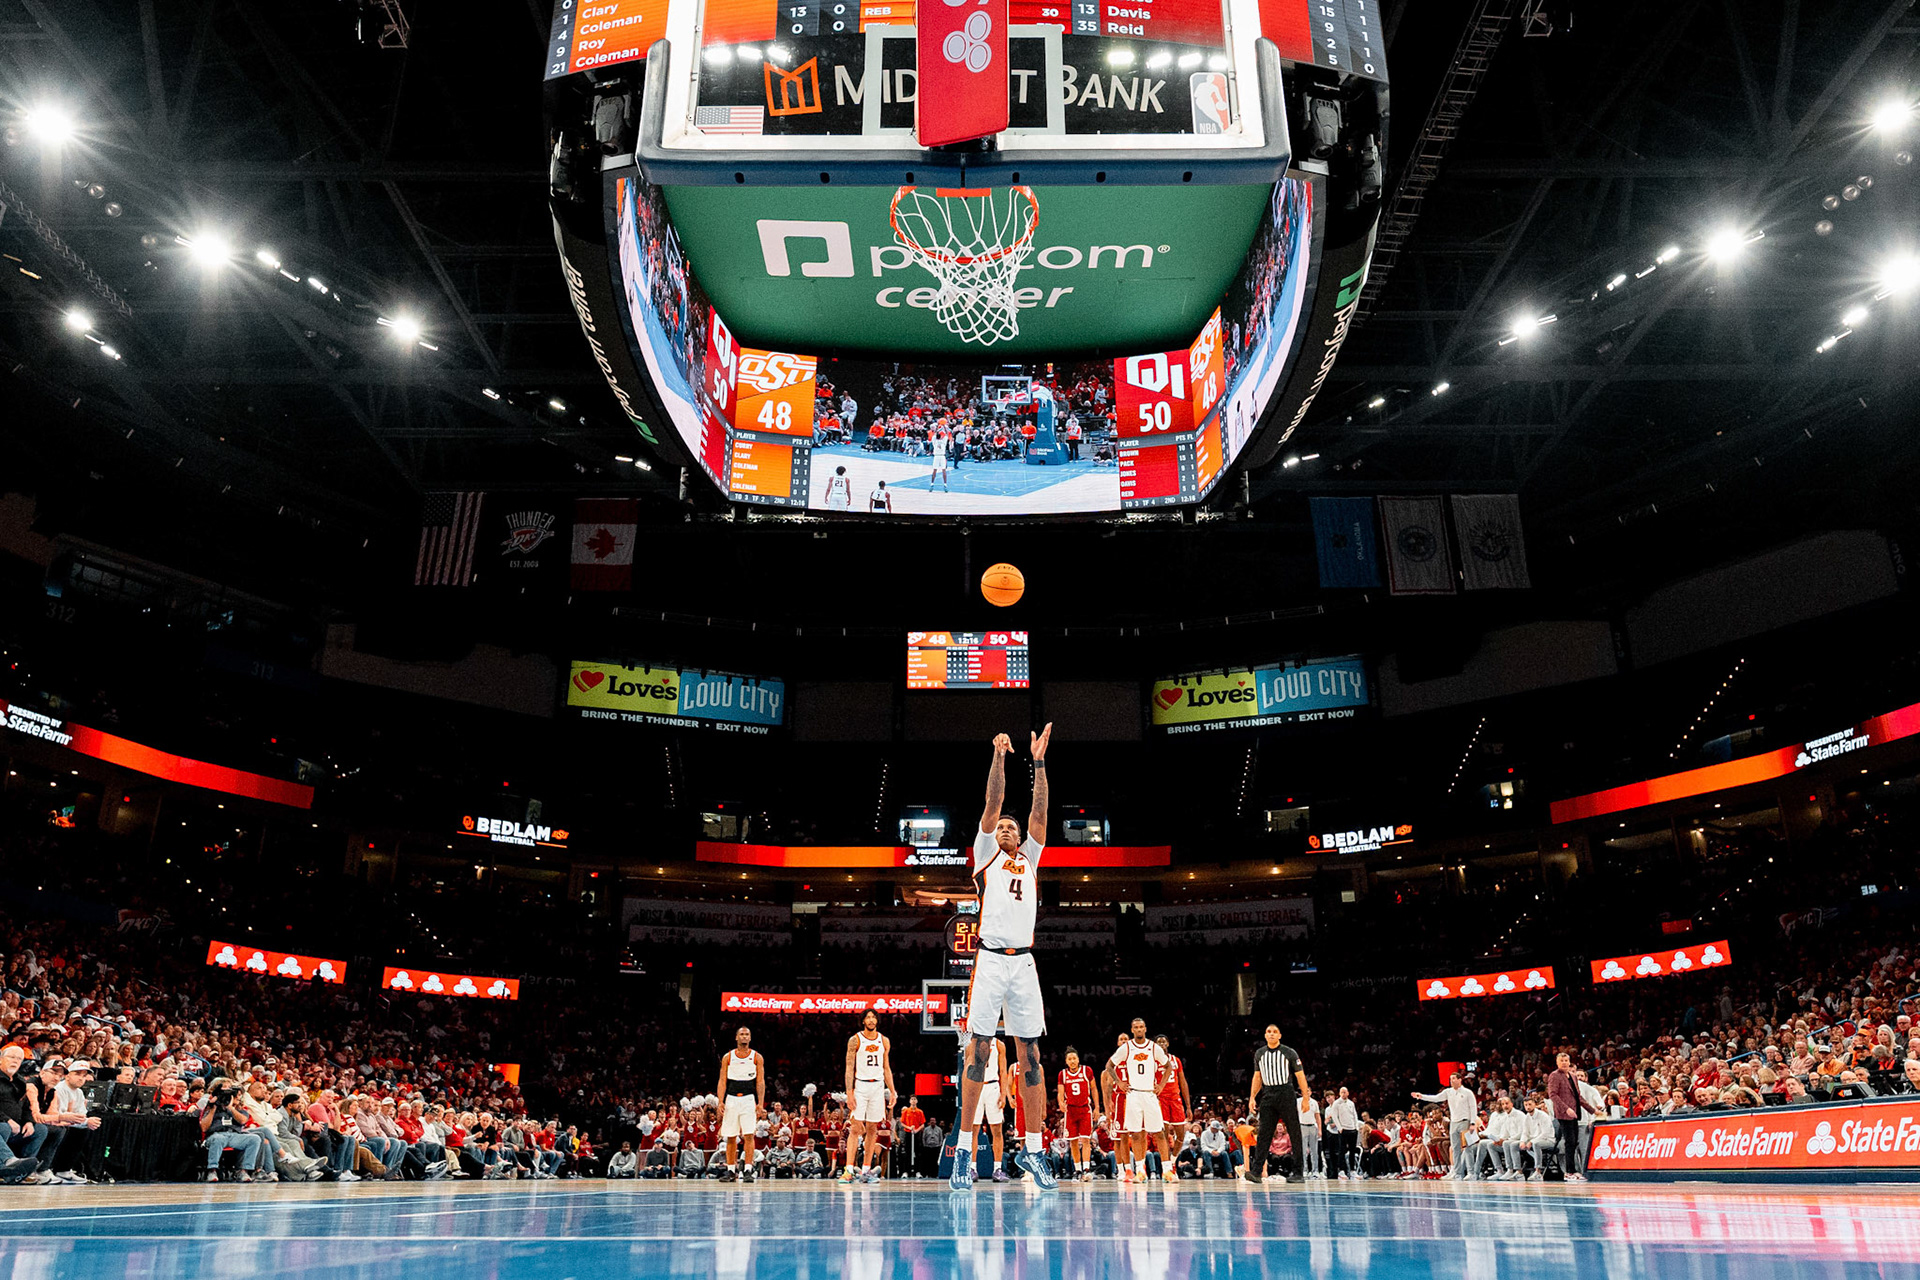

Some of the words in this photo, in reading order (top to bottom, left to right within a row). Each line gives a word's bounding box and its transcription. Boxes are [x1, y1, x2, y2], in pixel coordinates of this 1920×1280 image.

[582, 4, 618, 19] Clary
[790, 6, 807, 18] 13
[834, 4, 846, 15] 0
[864, 7, 892, 16] REB
[1042, 8, 1059, 17] 30
[1078, 4, 1095, 14] 13
[1108, 6, 1151, 19] Davis
[1320, 6, 1335, 18] 15
[1360, 16, 1366, 26] 1
[562, 14, 568, 24] 1
[580, 14, 642, 35] Coleman
[792, 23, 803, 34] 0
[832, 20, 844, 32] 0
[1078, 20, 1097, 31] 35
[1108, 22, 1144, 36] Reid
[1324, 22, 1334, 32] 9
[1362, 32, 1368, 42] 1
[558, 30, 568, 40] 4
[578, 38, 606, 52] Roy
[1326, 38, 1336, 49] 2
[1364, 48, 1370, 58] 1
[556, 46, 566, 57] 9
[576, 48, 639, 68] Coleman
[1328, 54, 1338, 65] 5
[1364, 63, 1374, 74] 0
[550, 62, 566, 74] 21
[1199, 122, 1218, 134] NBA
[875, 284, 1075, 308] ceer
[1310, 301, 1355, 391] paycom
[712, 368, 728, 410] 50
[1202, 371, 1217, 410] 48
[757, 400, 792, 431] 48
[1138, 400, 1172, 432] 50
[736, 432, 756, 440] PLAYER
[792, 438, 802, 446] PTS
[1120, 440, 1140, 448] PLAYER
[1176, 434, 1186, 442] PTS
[1120, 460, 1134, 468] PACK
[732, 472, 744, 480] ROY
[834, 480, 844, 488] 21
[790, 498, 806, 506] 12:16
[504, 510, 556, 529] THUNDER
[510, 560, 522, 568] EST.
[928, 634, 947, 644] 48
[990, 634, 1008, 644] 50
[1262, 675, 1312, 710] LOUD
[1318, 669, 1362, 698] CITY
[683, 682, 733, 711] LOUD
[740, 685, 780, 718] CITY
[7, 704, 50, 726] PRESENTED
[50, 718, 62, 728] BY
[581, 710, 618, 720] BRING
[620, 713, 644, 723] THE
[646, 716, 700, 728] THUNDER
[716, 722, 741, 732] EXIT
[743, 725, 769, 735] NOW
[1167, 724, 1202, 735] BRING
[1204, 722, 1226, 732] THE
[1228, 716, 1282, 730] THUNDER
[1298, 712, 1324, 722] EXIT
[1328, 709, 1354, 720] NOW
[1805, 731, 1843, 750] PRESENTED
[1843, 727, 1854, 739] BY
[476, 816, 551, 842] BEDLAM
[1322, 825, 1394, 848] BEDLAM
[491, 834, 536, 847] BASKETBALL
[916, 848, 948, 856] PRESENTED
[1008, 878, 1023, 902] 4
[735, 914, 780, 927] TERRACE
[1162, 915, 1185, 928] POST
[1198, 914, 1217, 924] OAK
[1220, 912, 1253, 924] PARTY
[1255, 908, 1302, 924] TERRACE
[956, 922, 977, 933] 12:1
[1053, 984, 1153, 998] THUNDER
[867, 1054, 879, 1067] 21
[1138, 1063, 1144, 1075] 0
[1072, 1083, 1081, 1096] 9
[1836, 1116, 1920, 1154] StateFa
